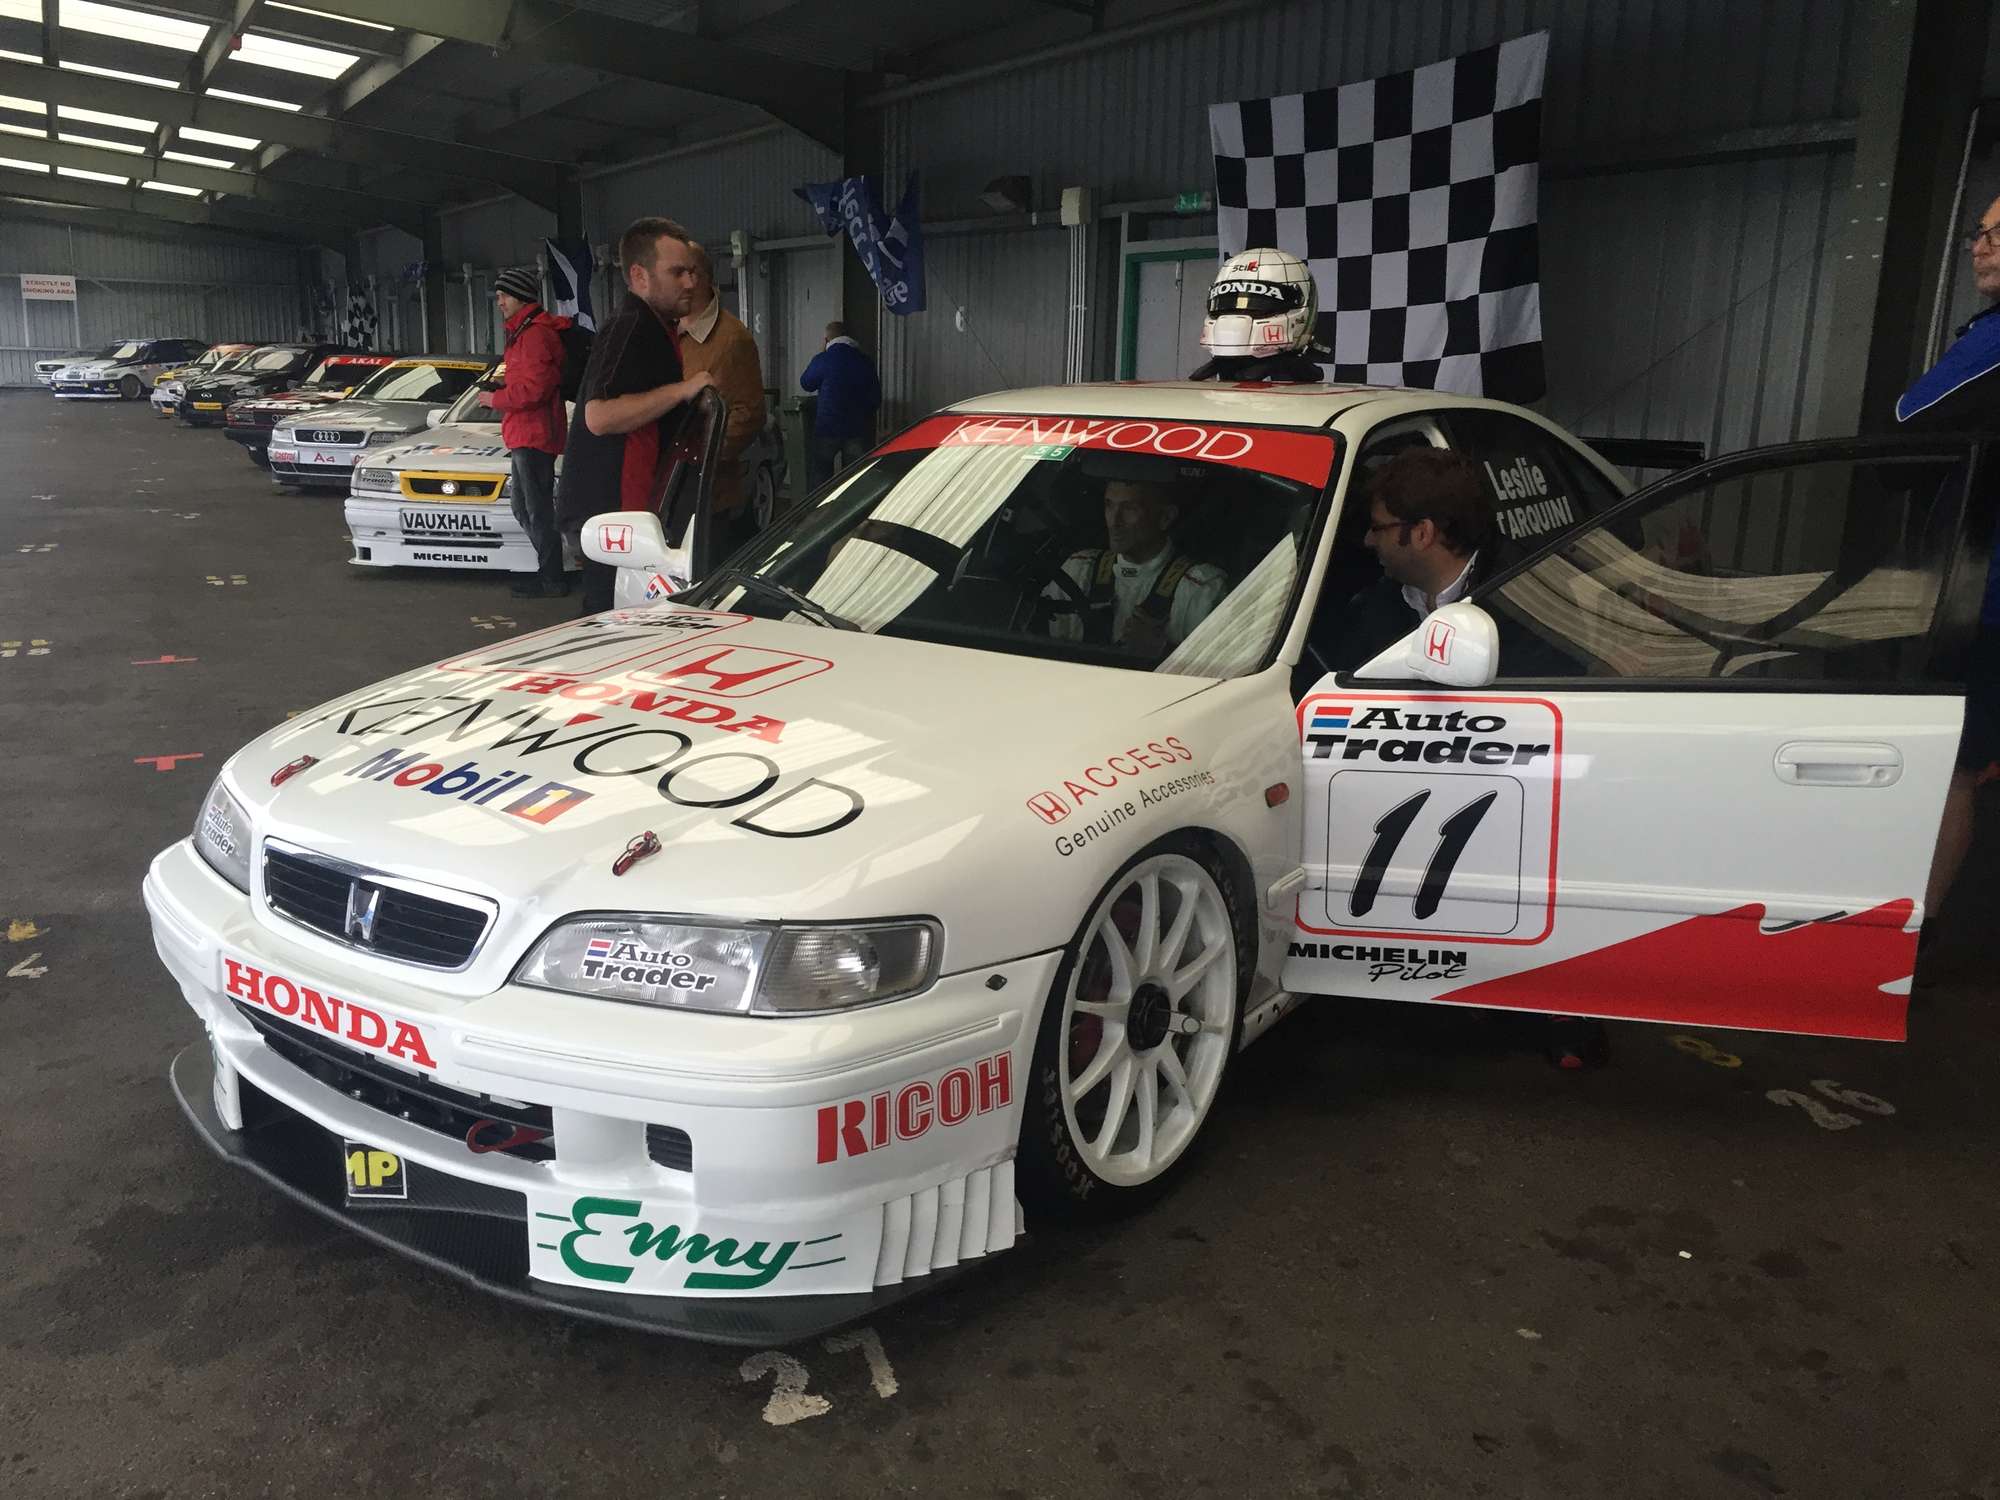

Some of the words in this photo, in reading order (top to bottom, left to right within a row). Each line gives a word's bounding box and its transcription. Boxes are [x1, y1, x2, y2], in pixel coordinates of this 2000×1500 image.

[1210, 282, 1284, 300] HONDA
[347, 357, 383, 365] AKAI
[940, 419, 1254, 461] KENWOOD
[314, 453, 336, 463] A4
[1484, 457, 1548, 501] Leslie
[402, 512, 492, 531] VAUXHALL
[413, 552, 488, 563] MICHELIN
[499, 675, 788, 744] HONDA
[1351, 707, 1507, 733] Auto
[299, 692, 866, 839] KENWOOD
[1305, 733, 1551, 766] Trader
[342, 748, 527, 807] Mobil
[1063, 736, 1193, 806] ACCESS
[211, 810, 233, 834] Auto
[1055, 802, 1137, 857] Genuine
[1138, 770, 1215, 809] Accessories
[1349, 788, 1498, 920] 11
[609, 942, 691, 967] Auto
[1286, 942, 1467, 967] MICHELIN
[583, 959, 716, 990] Trader
[1367, 961, 1466, 983] Pilot
[225, 958, 438, 1070] HONDA
[816, 1049, 1014, 1164] RICOH
[559, 1195, 802, 1291] Enny
